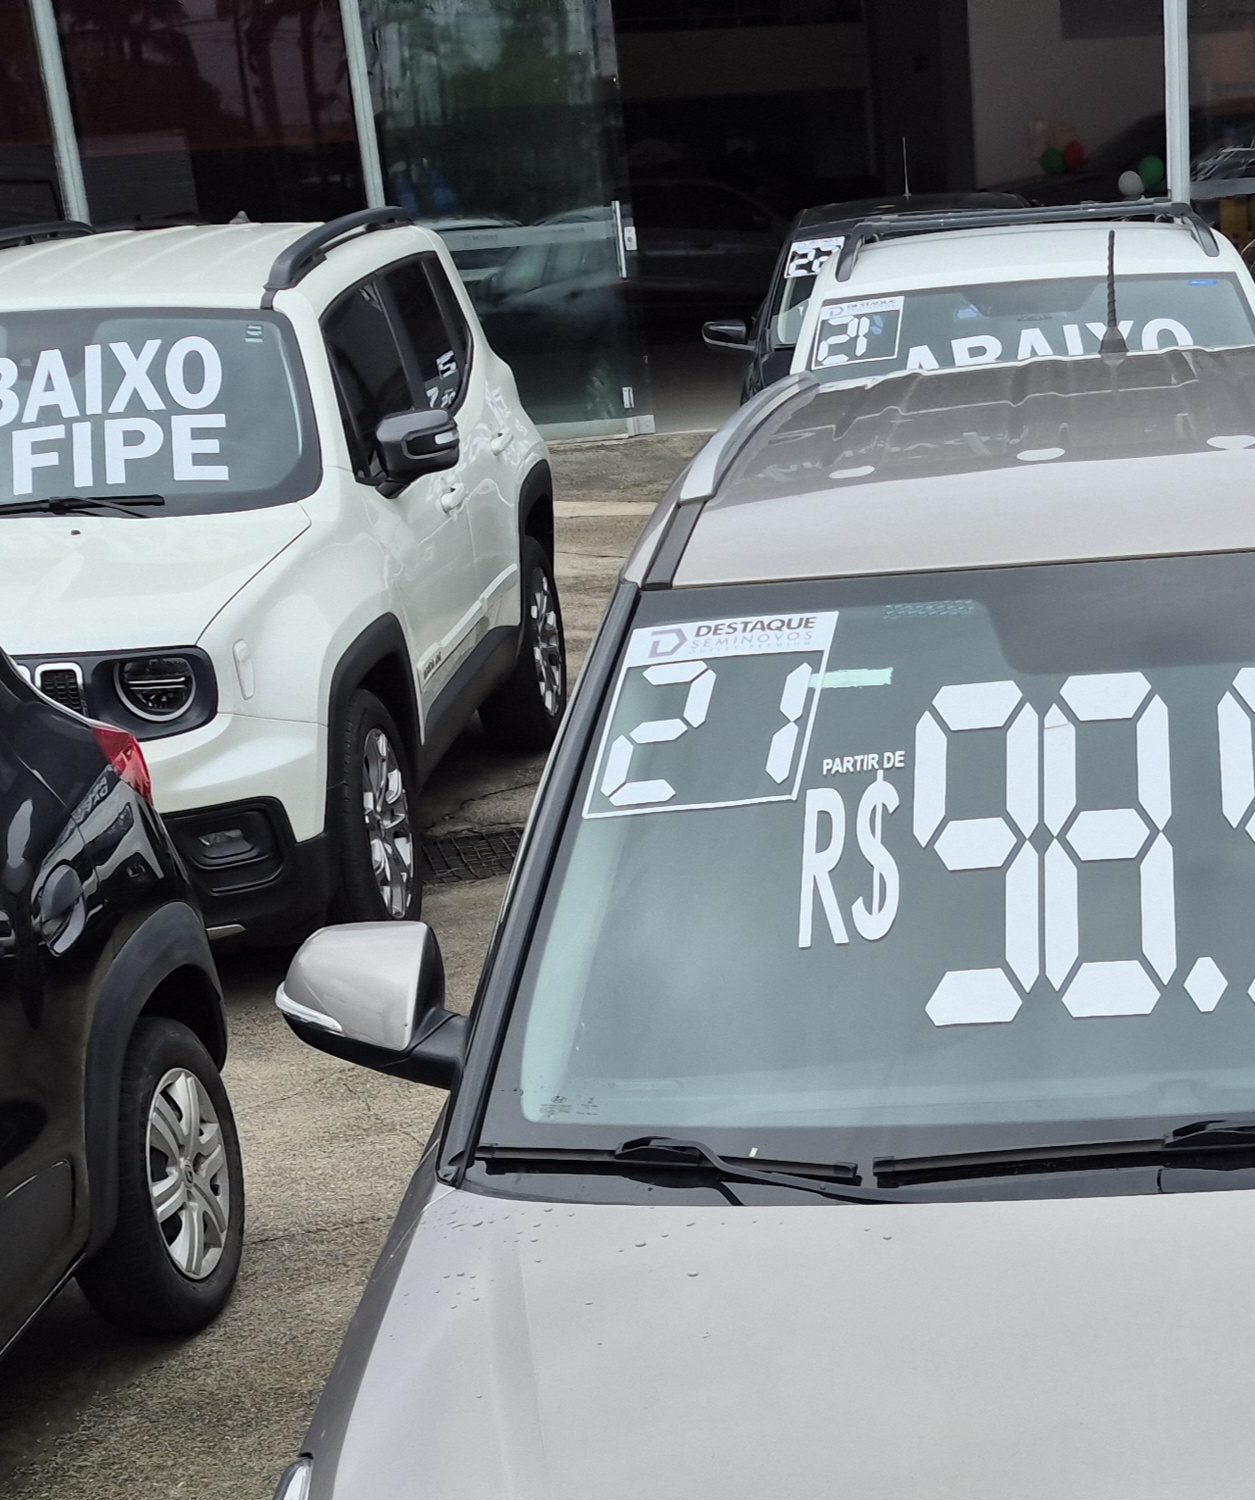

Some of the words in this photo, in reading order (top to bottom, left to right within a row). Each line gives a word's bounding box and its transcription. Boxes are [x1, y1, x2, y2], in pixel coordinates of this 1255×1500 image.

[817, 315, 870, 365] 21
[12, 414, 229, 495] FIPE
[691, 631, 813, 649] SEMINOVOS
[694, 617, 817, 638] DESTAQUE
[600, 661, 812, 806] 21
[823, 753, 879, 775] PARTIR
[883, 750, 905, 768] DE
[798, 770, 900, 948] R$
